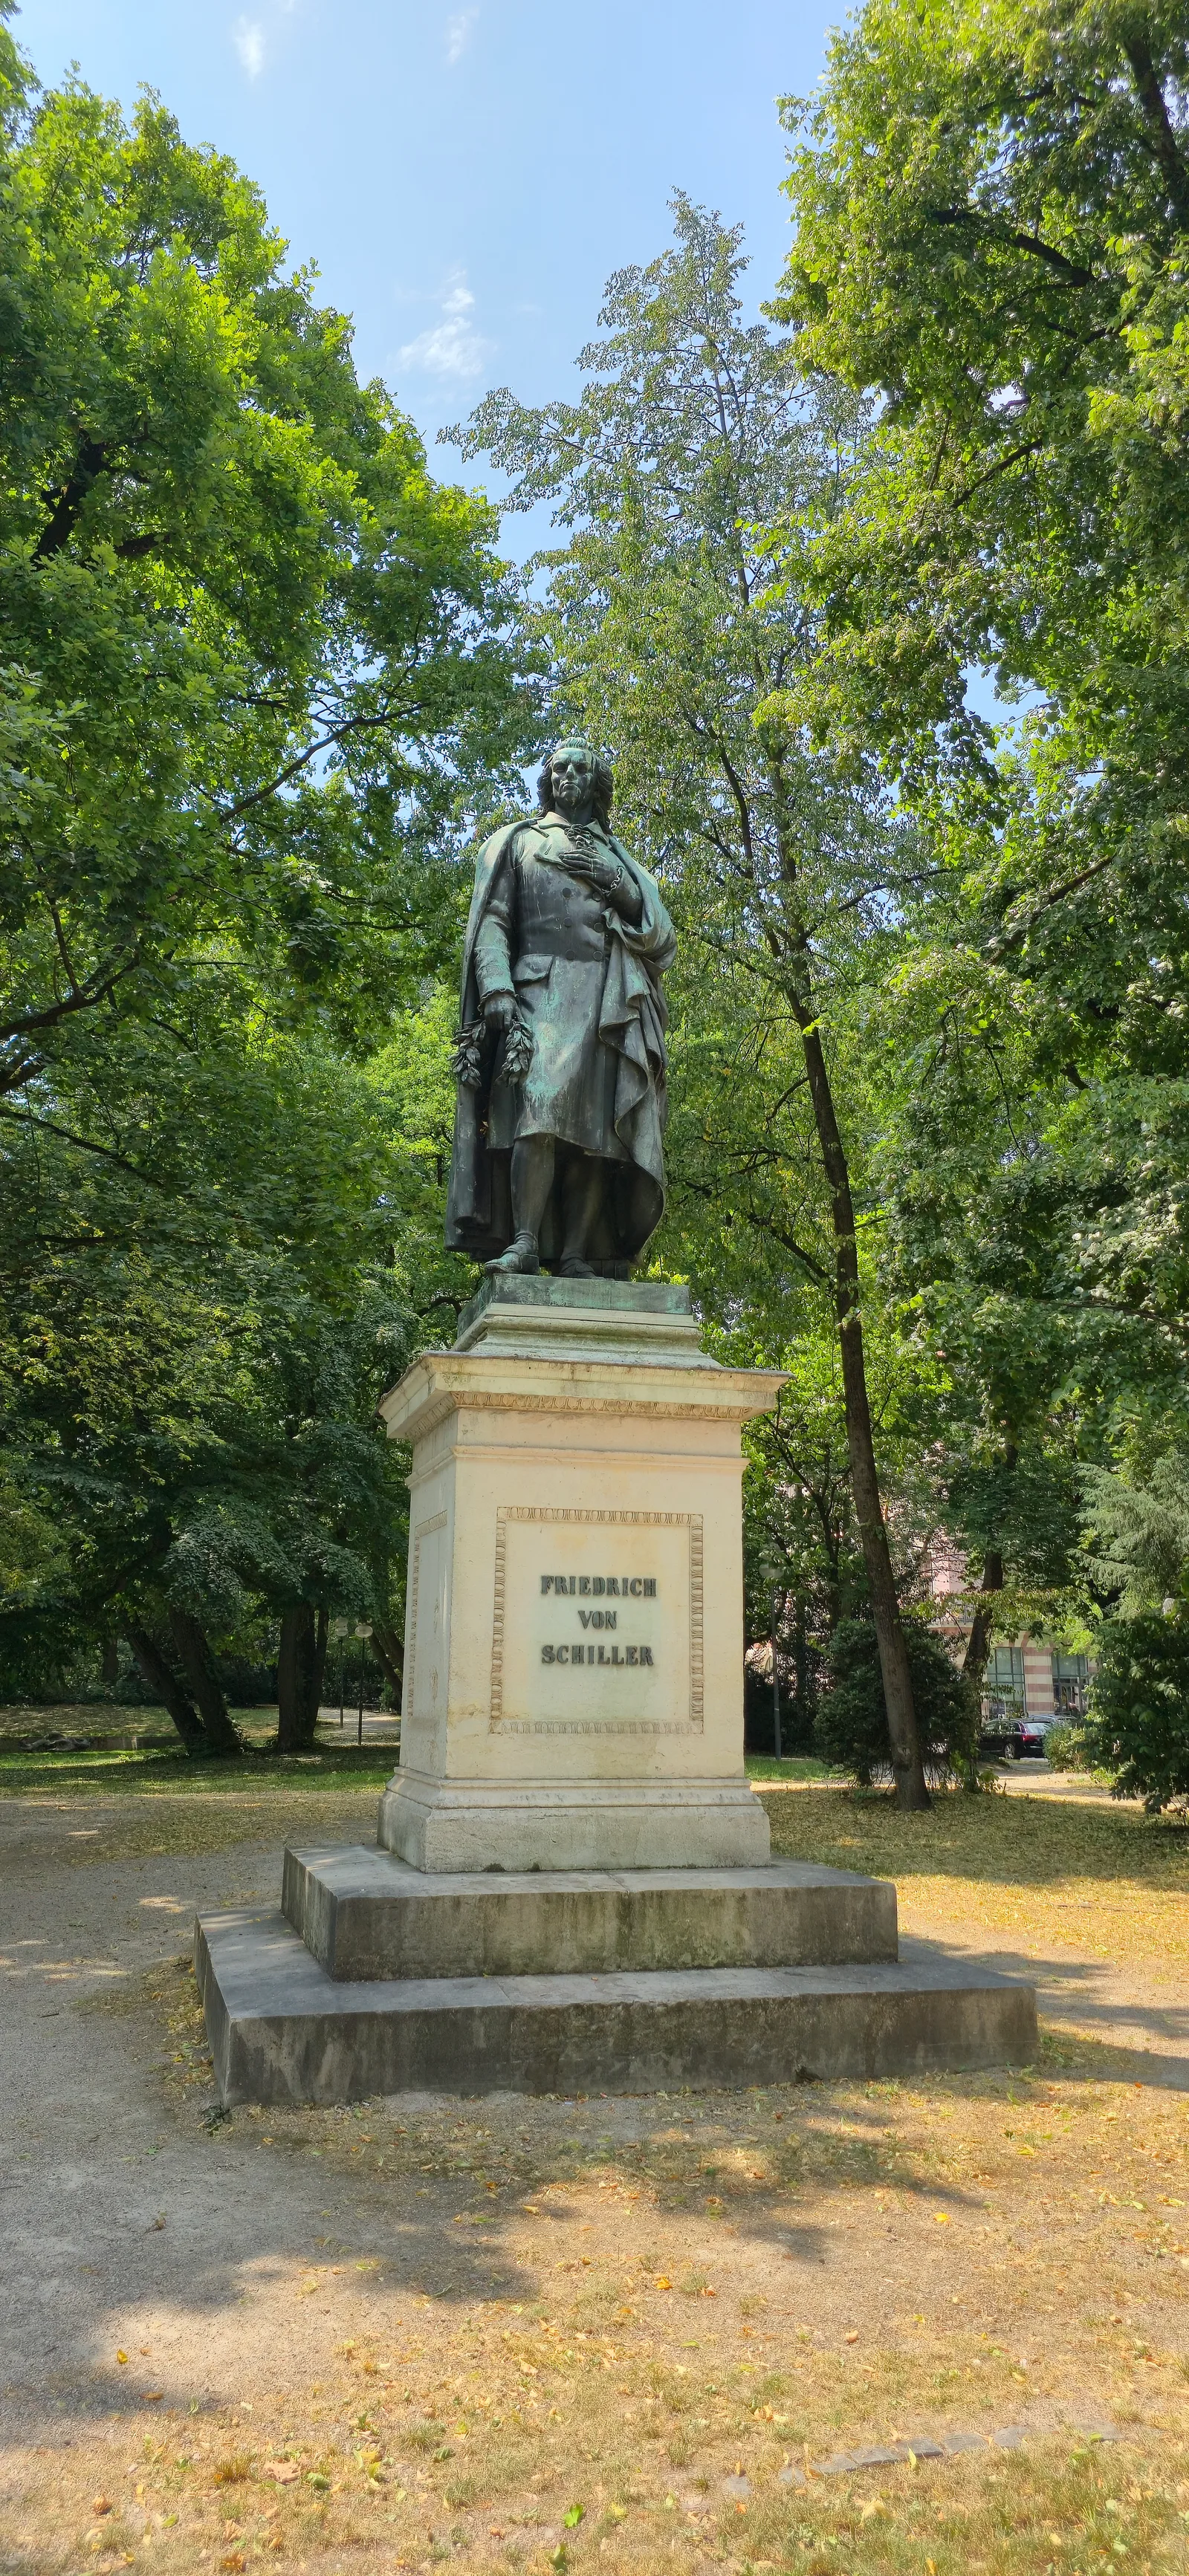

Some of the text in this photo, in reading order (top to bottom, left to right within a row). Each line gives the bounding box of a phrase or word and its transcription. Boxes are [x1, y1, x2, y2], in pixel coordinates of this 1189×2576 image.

[541, 1575, 656, 1597] FRIEDRICH
[577, 1610, 617, 1629] VON
[541, 1645, 654, 1666] SCHILLER
